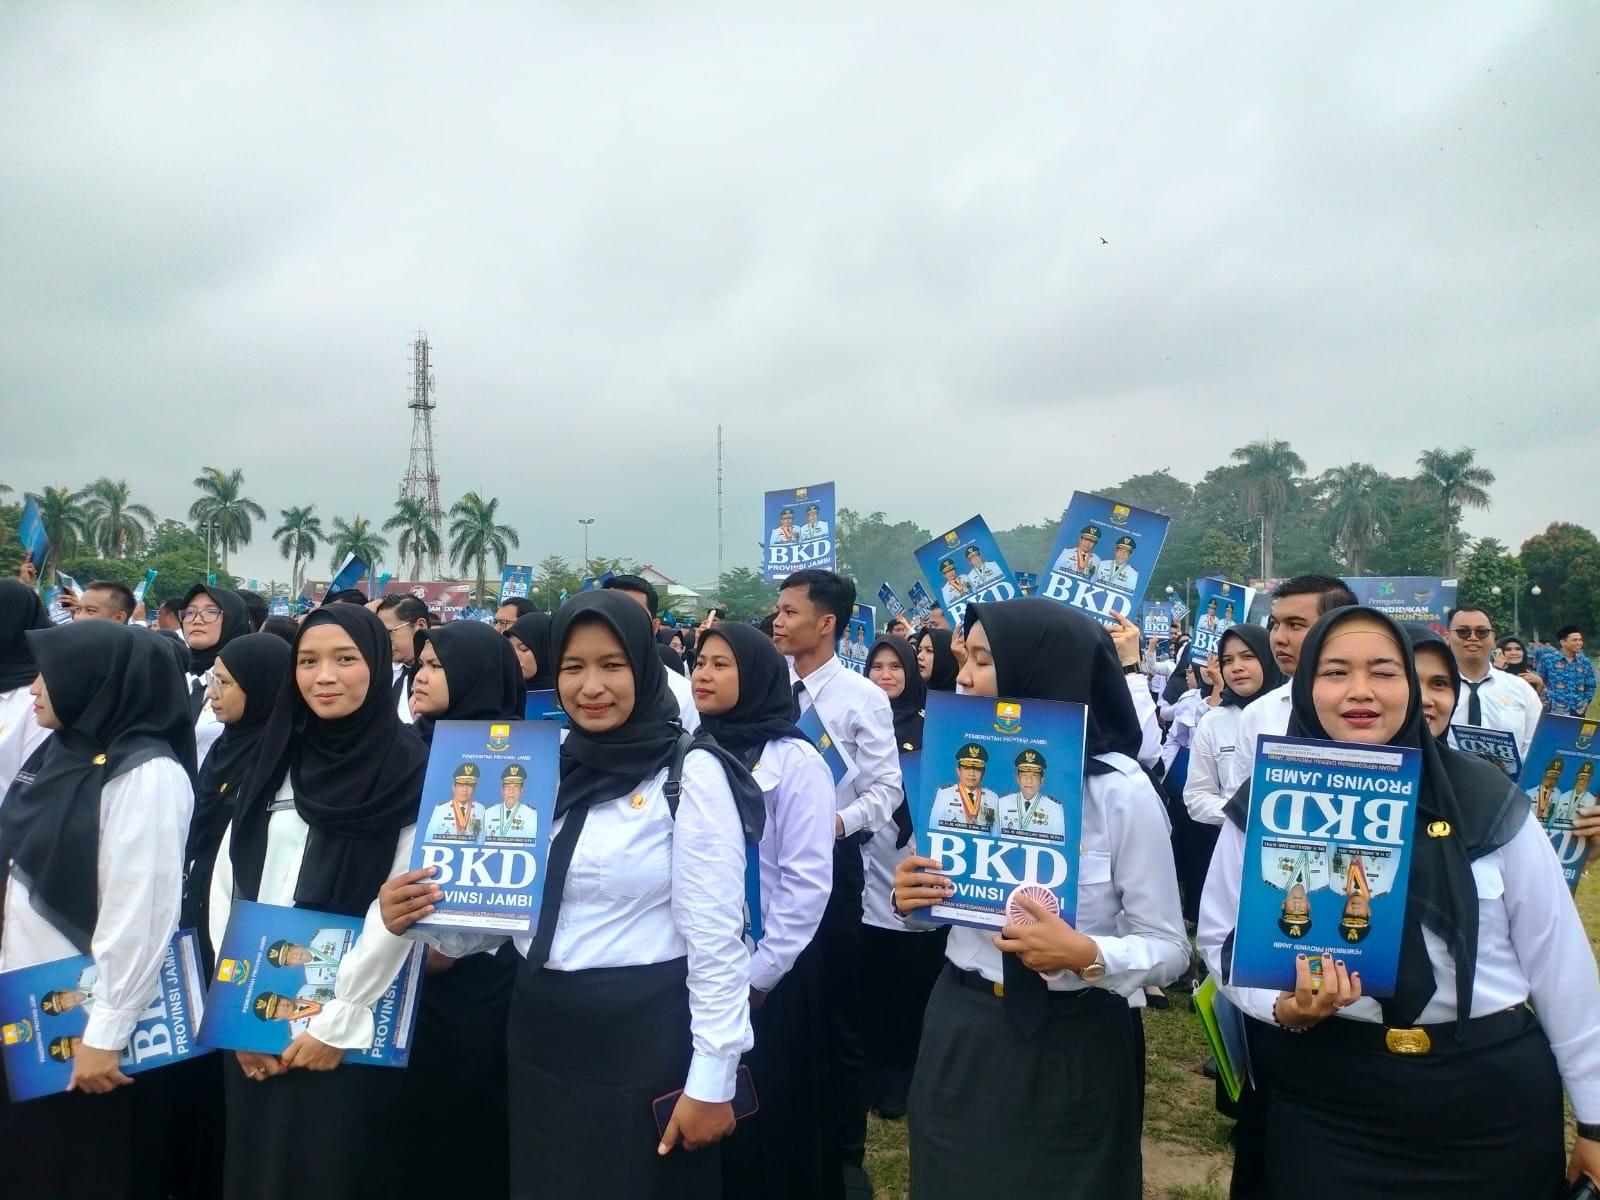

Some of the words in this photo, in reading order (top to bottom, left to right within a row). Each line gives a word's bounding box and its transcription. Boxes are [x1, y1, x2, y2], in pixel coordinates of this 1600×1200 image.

[769, 540, 831, 563] BKD
[767, 562, 806, 571] PROVINSI
[1043, 572, 1131, 620] BKD
[1144, 623, 1169, 631] BKD
[1389, 613, 1416, 621] AHUN
[1193, 631, 1220, 652] BK
[965, 733, 1002, 742] PEMERINTAH
[1460, 739, 1516, 760] BKD
[1265, 767, 1322, 786] JAMBI
[1327, 774, 1413, 795] PROVINSI
[1260, 789, 1408, 845] BKD
[421, 845, 537, 889] BKD
[925, 832, 1068, 889] BKD
[486, 893, 532, 907] JAMBI
[1273, 941, 1292, 949] JAMBI
[1294, 943, 1324, 953] PROVINSI
[1325, 947, 1361, 955] PEMERINTAH
[133, 978, 173, 1064] BK
[168, 988, 189, 1055] PROVINSI
[371, 985, 397, 1058] PROVINSI
